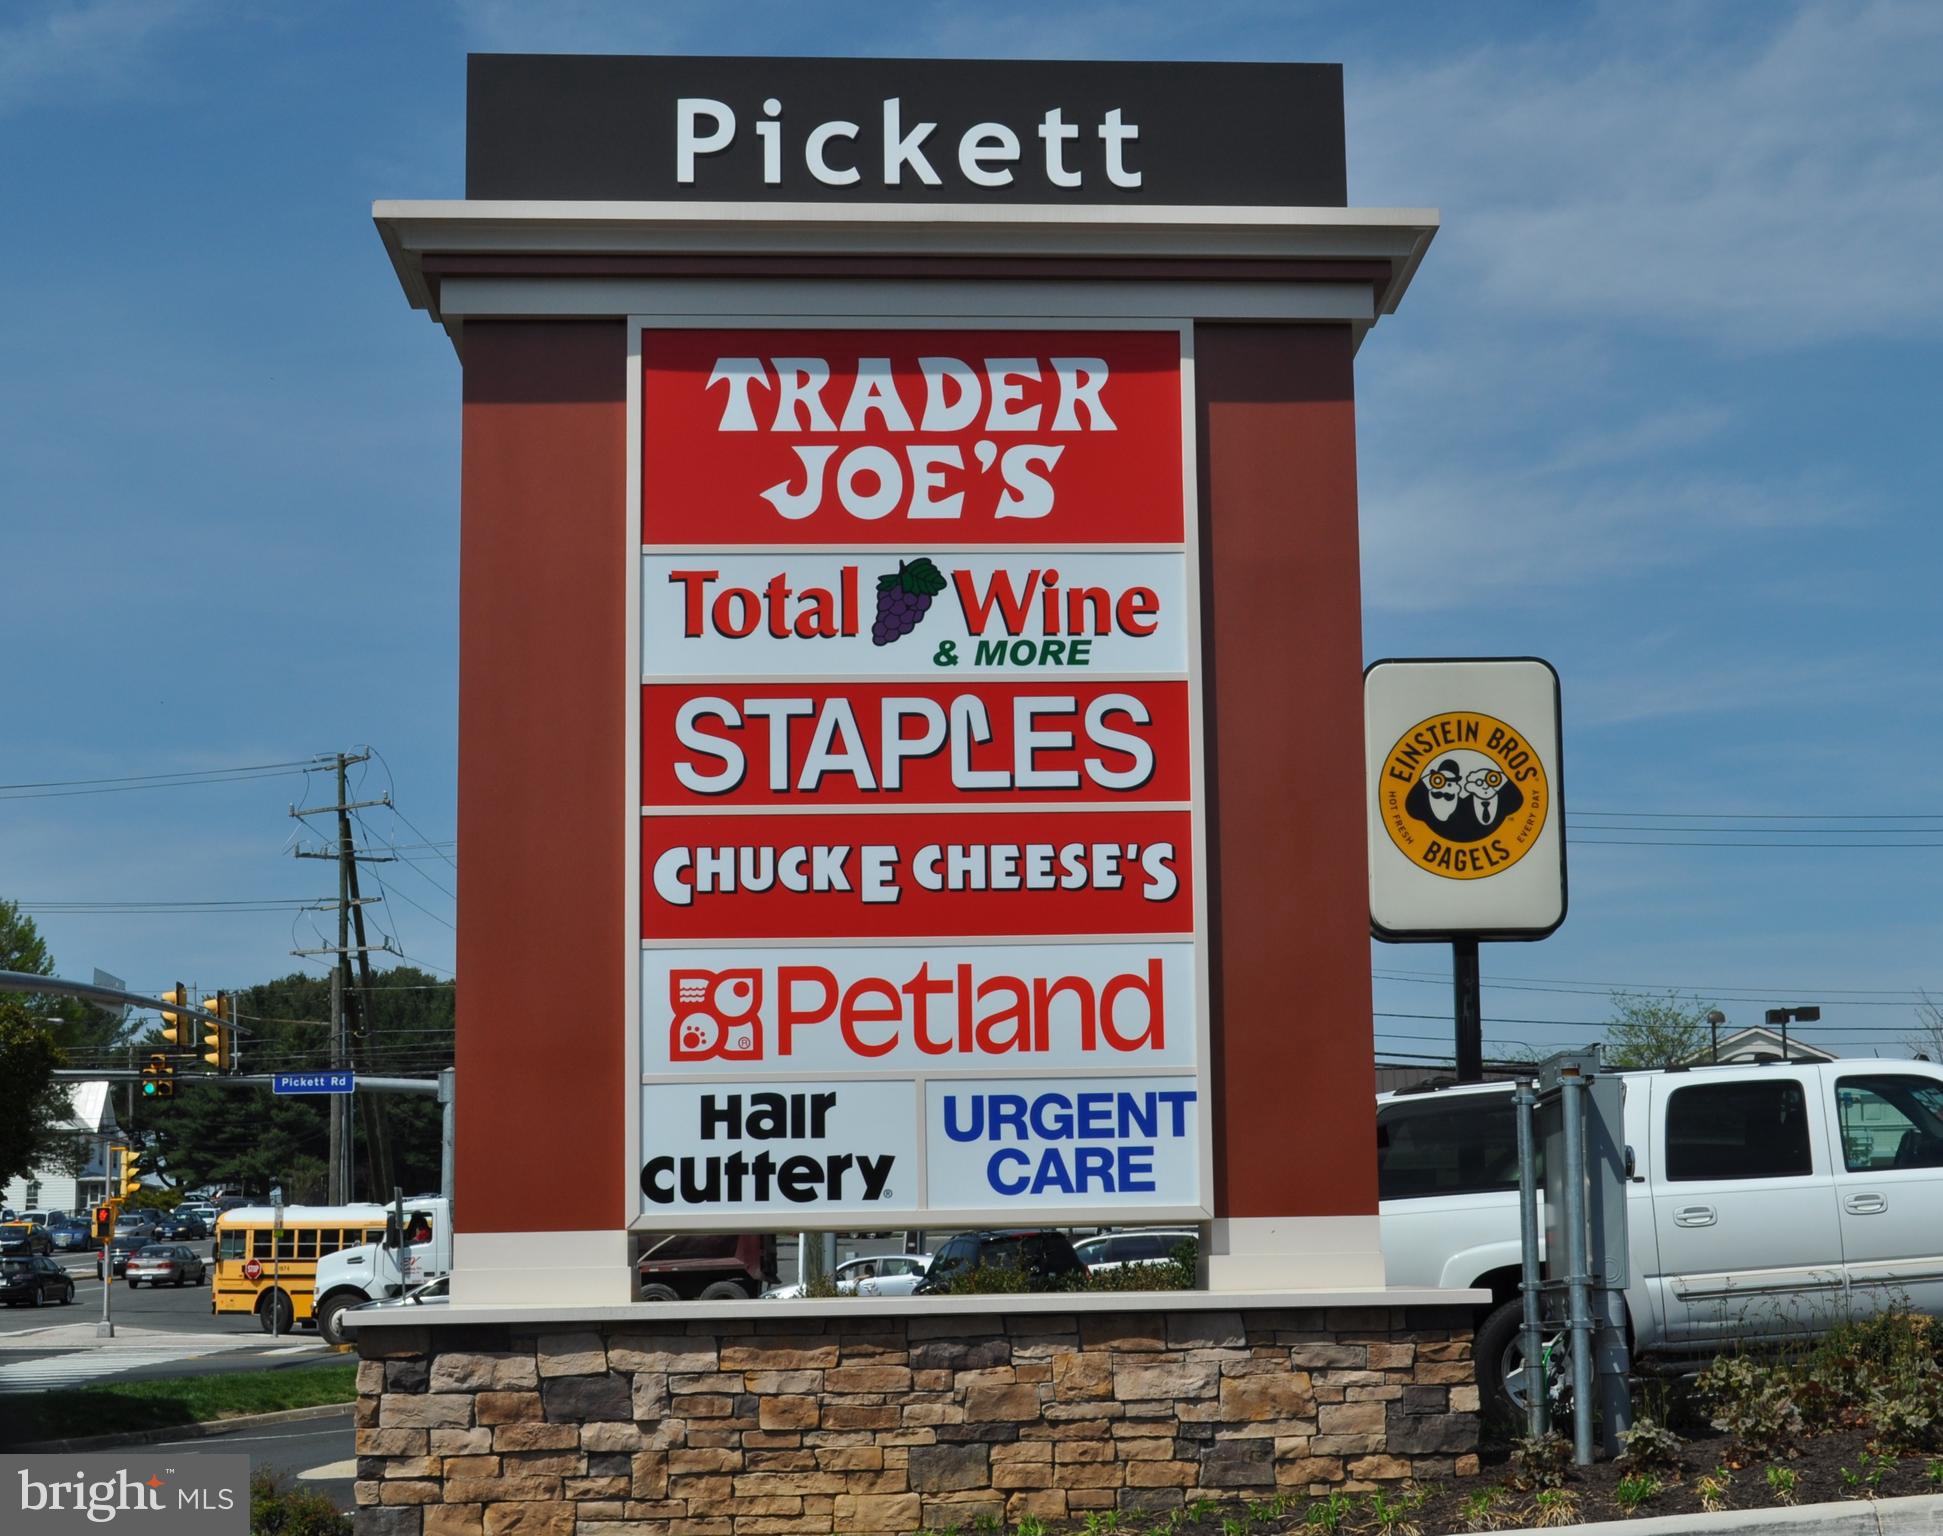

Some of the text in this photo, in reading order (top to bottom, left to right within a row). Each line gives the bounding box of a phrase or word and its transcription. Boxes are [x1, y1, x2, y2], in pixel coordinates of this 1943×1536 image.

[677, 97, 1142, 188] Pickett
[705, 357, 1117, 432] TRADER
[760, 440, 1065, 520] JOE'S
[668, 566, 1160, 639] Total Wine
[932, 639, 1092, 667] & MORE
[673, 693, 1155, 792] STAPLES
[1389, 719, 1538, 783] EINSTEIN BROS
[1388, 791, 1415, 845] HOT FRESH
[1516, 790, 1540, 844] EVERY DAY
[652, 841, 1180, 906] CHUCK E CHEESE'S
[1423, 839, 1510, 871] BAGELS
[778, 958, 1165, 1058] Petland
[281, 1076, 346, 1087] Pickett Rd
[700, 1091, 836, 1141] Hair
[943, 1091, 1198, 1142] URGENT
[987, 1146, 1156, 1196] CARE
[247, 1264, 259, 1273] STOP
